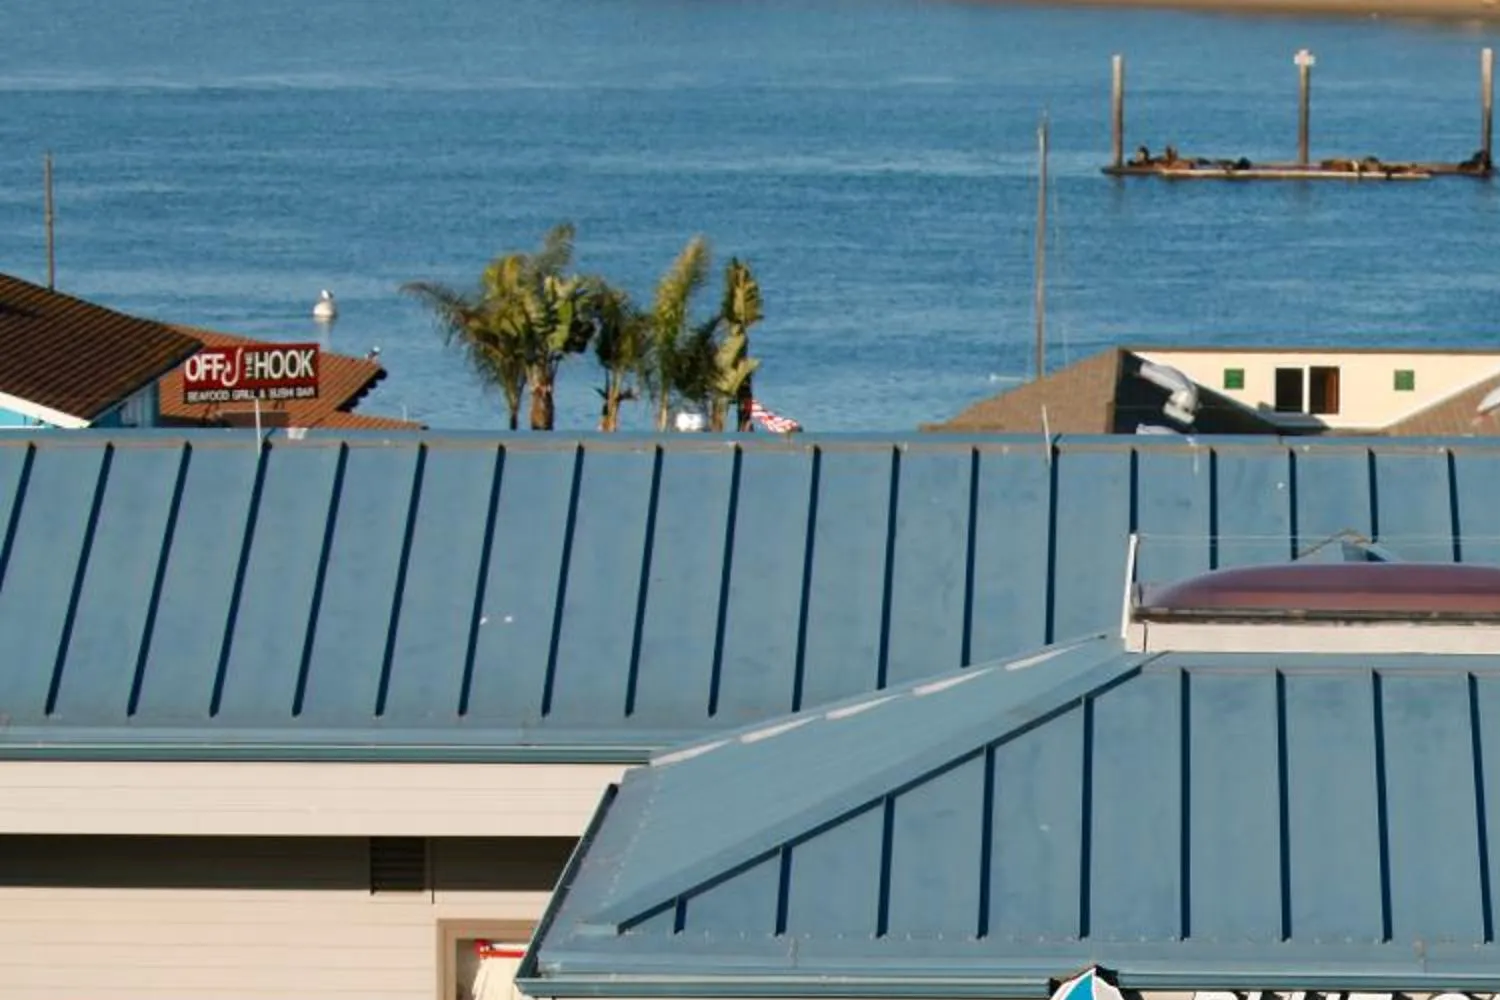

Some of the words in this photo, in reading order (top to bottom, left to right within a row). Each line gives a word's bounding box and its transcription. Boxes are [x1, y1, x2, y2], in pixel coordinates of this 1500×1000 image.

[185, 353, 225, 381] OFF
[244, 352, 256, 378] THE
[255, 349, 315, 379] HOOK
[187, 391, 230, 401] SEAFOOD
[232, 390, 255, 399] GRILL
[269, 387, 294, 399] SUSHI
[296, 387, 314, 396] BAR
